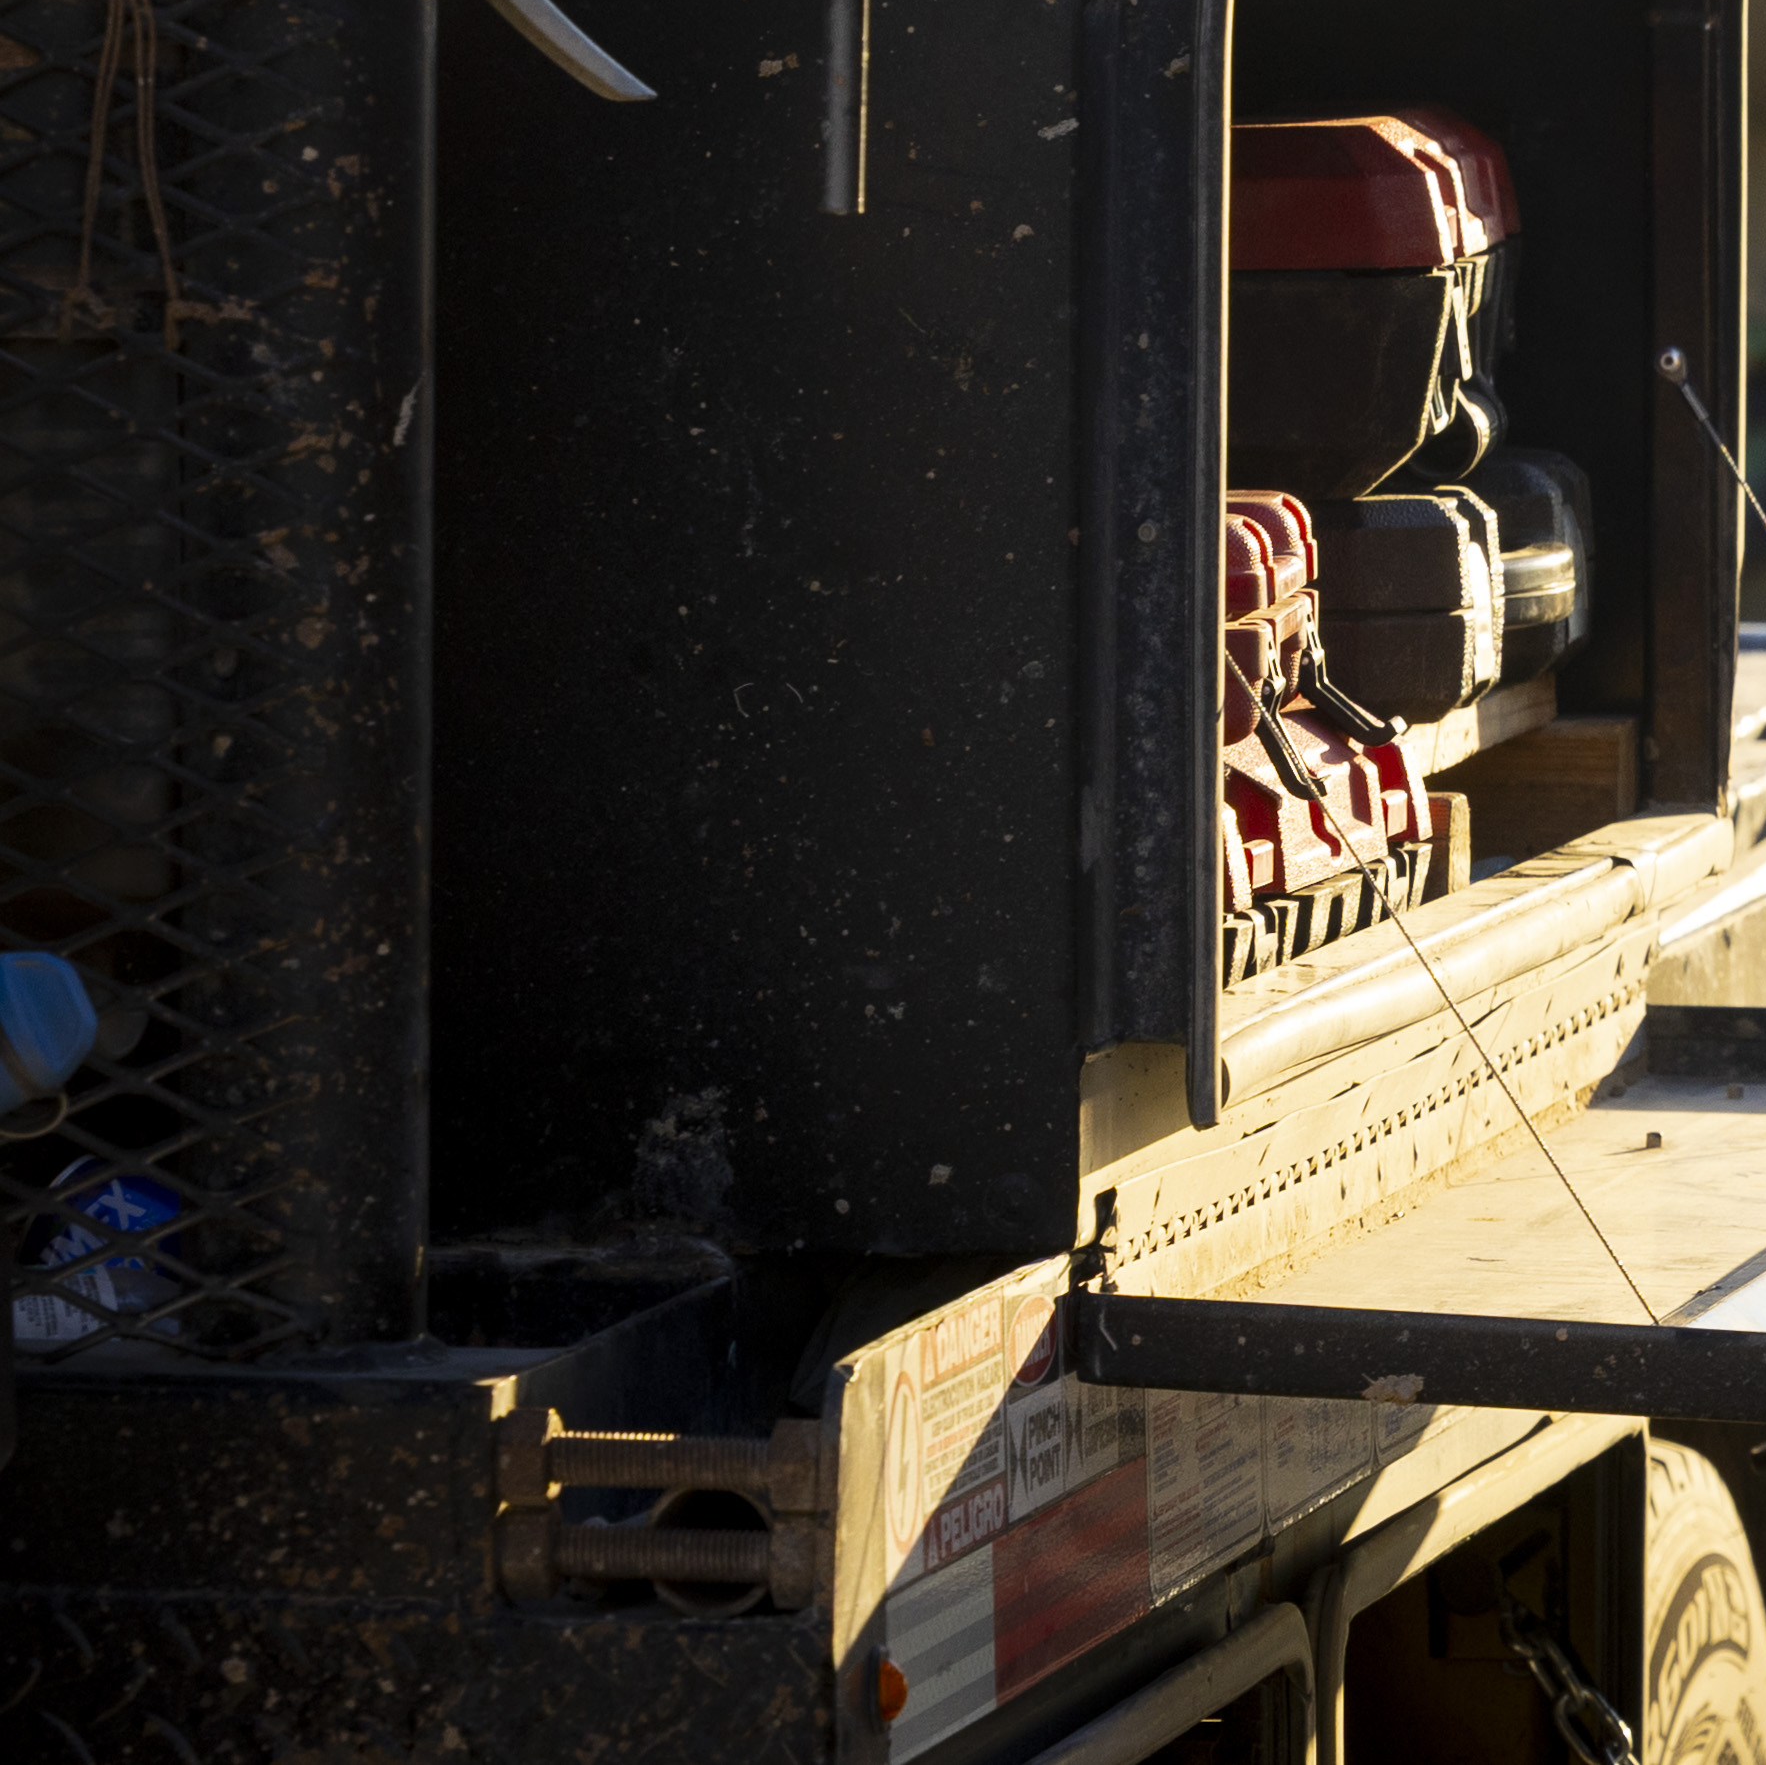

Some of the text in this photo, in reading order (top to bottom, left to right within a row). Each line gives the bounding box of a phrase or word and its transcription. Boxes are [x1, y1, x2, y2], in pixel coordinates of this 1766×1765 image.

[937, 1299, 1001, 1374] DANGER
[1028, 1401, 1061, 1450] PINCH
[1029, 1442, 1061, 1491] POINT
[940, 1483, 1003, 1558] PELIGRO
